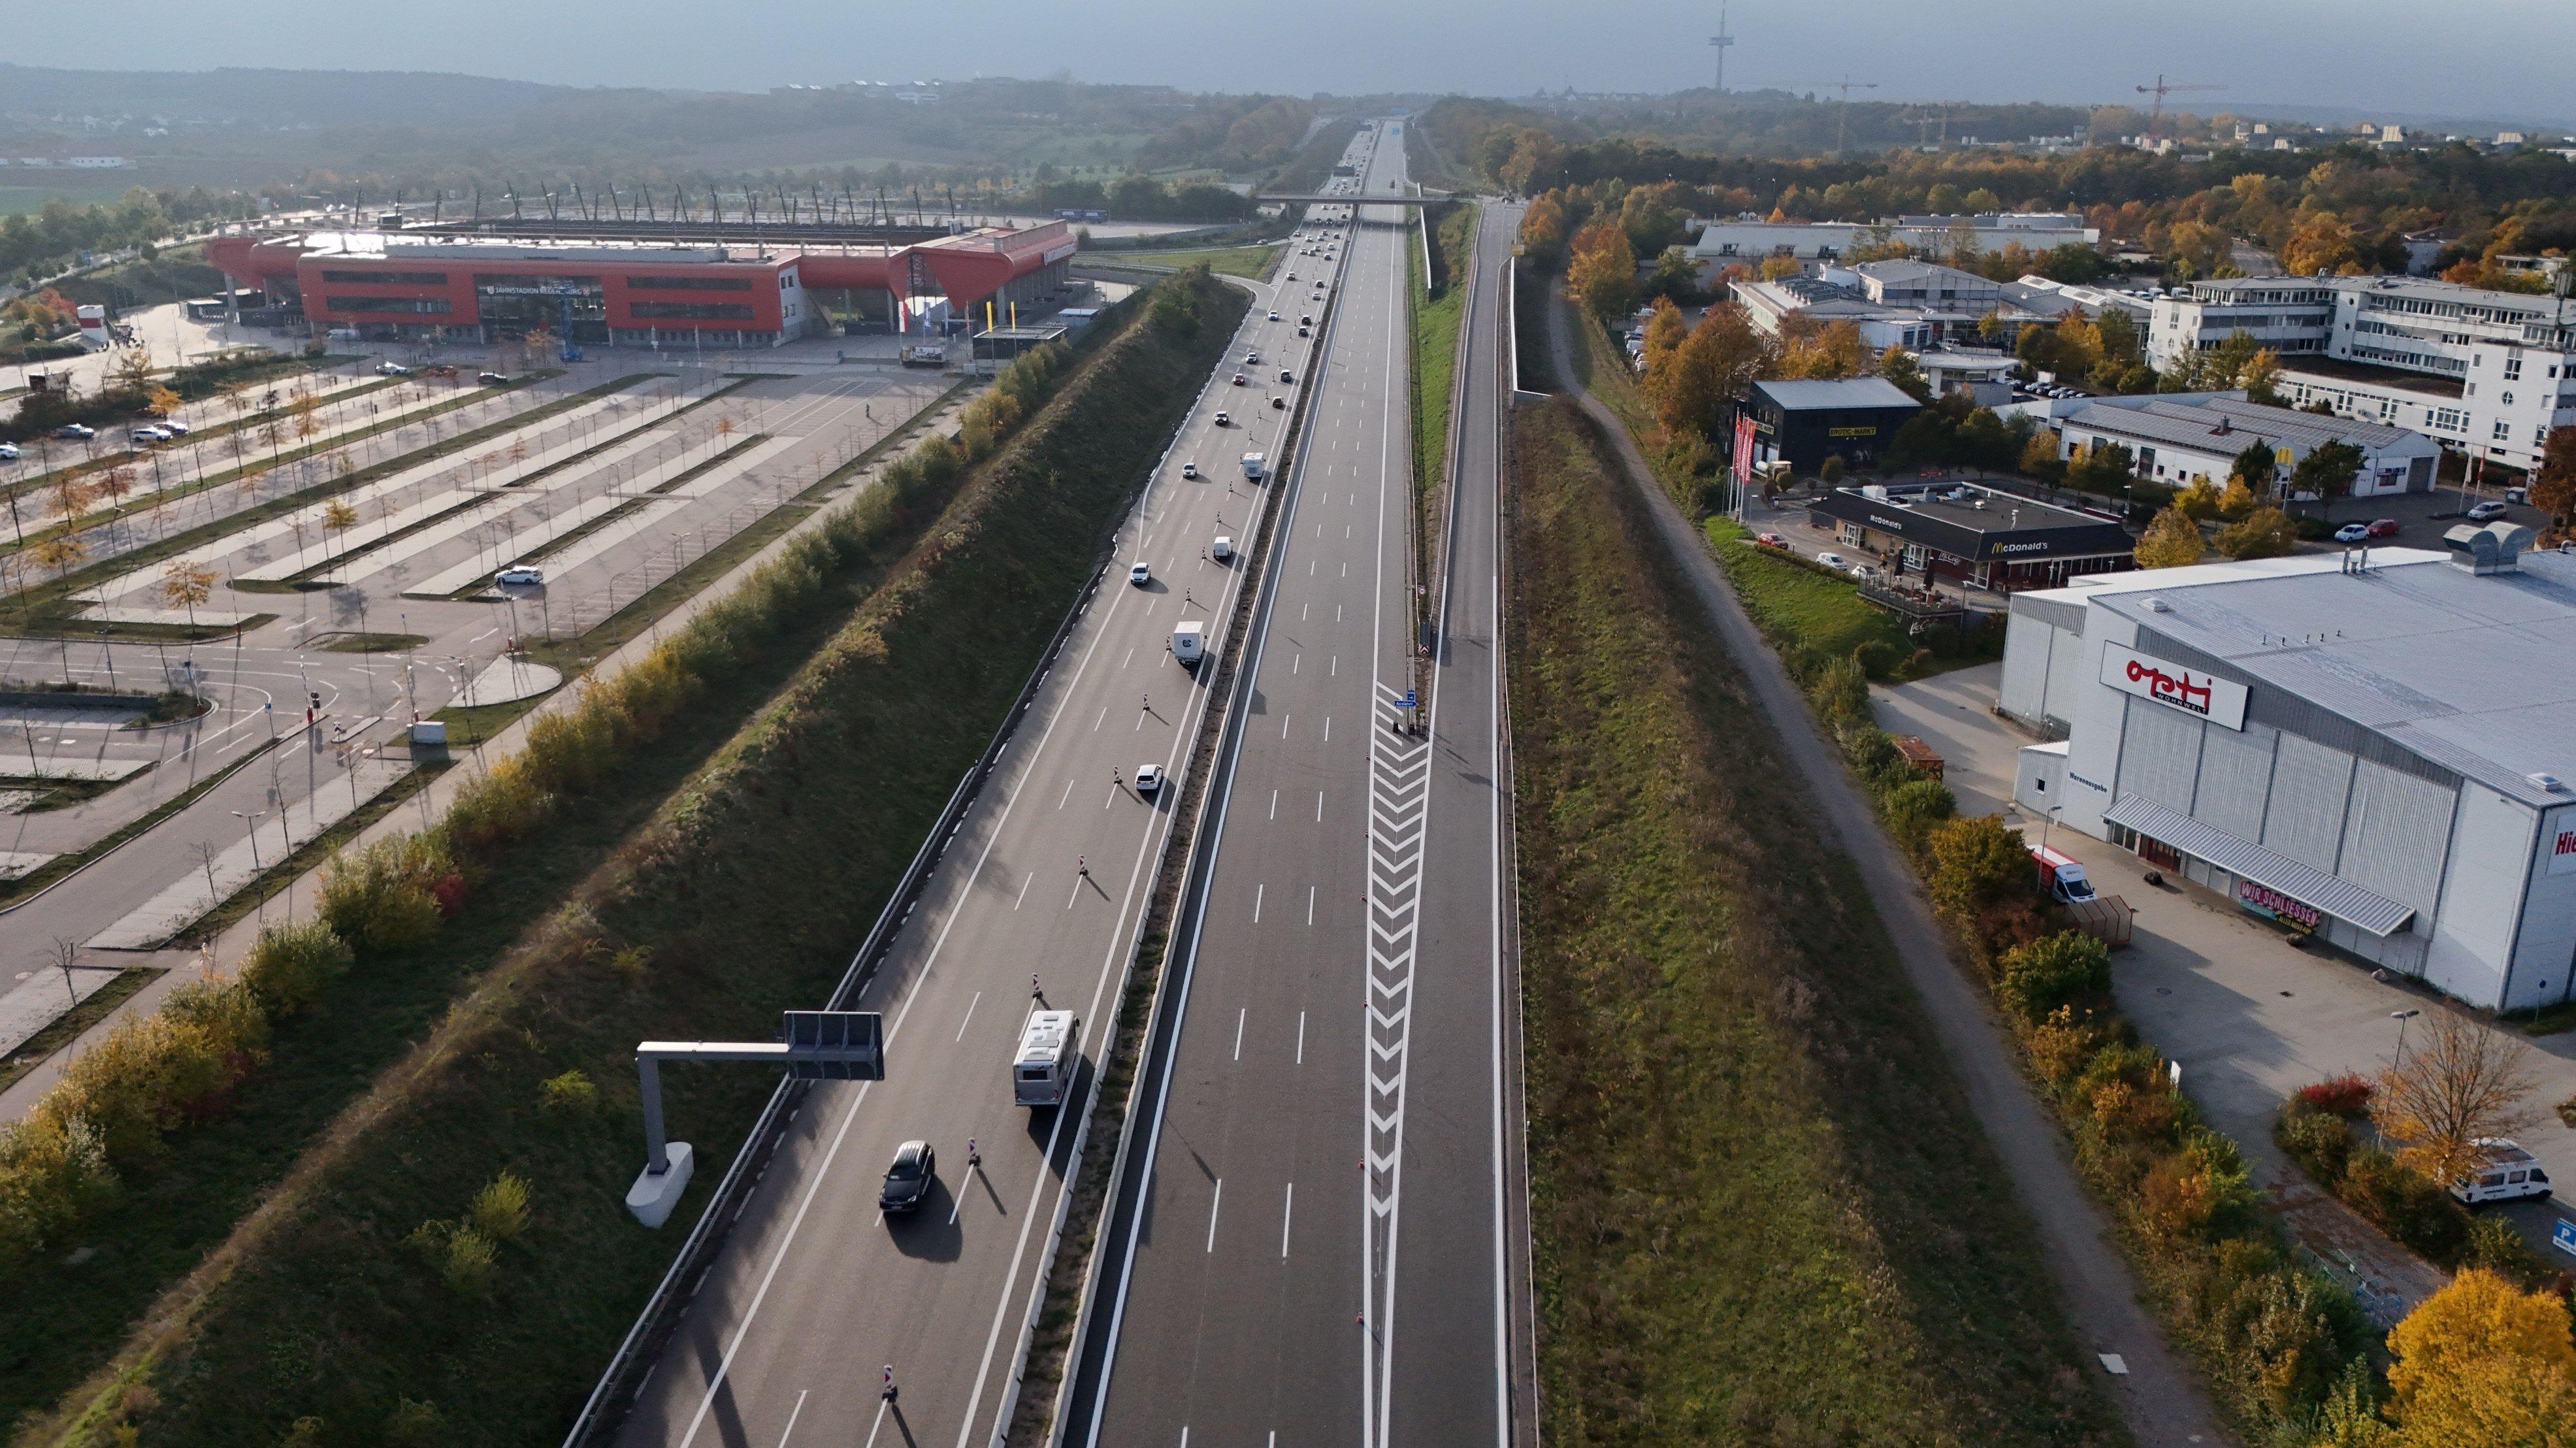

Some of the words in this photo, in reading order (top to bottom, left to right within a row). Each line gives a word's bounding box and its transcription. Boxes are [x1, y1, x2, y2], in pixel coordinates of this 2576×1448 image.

[1870, 514, 1902, 530] McDonald's
[1991, 542, 2047, 554] McDonald's
[2127, 660, 2212, 710] opti
[2157, 693, 2207, 714] WOHNWELT
[2069, 771, 2108, 793] Warenausgabe
[2241, 881, 2260, 901] WIR
[2263, 891, 2318, 925] SCHLIESSEN
